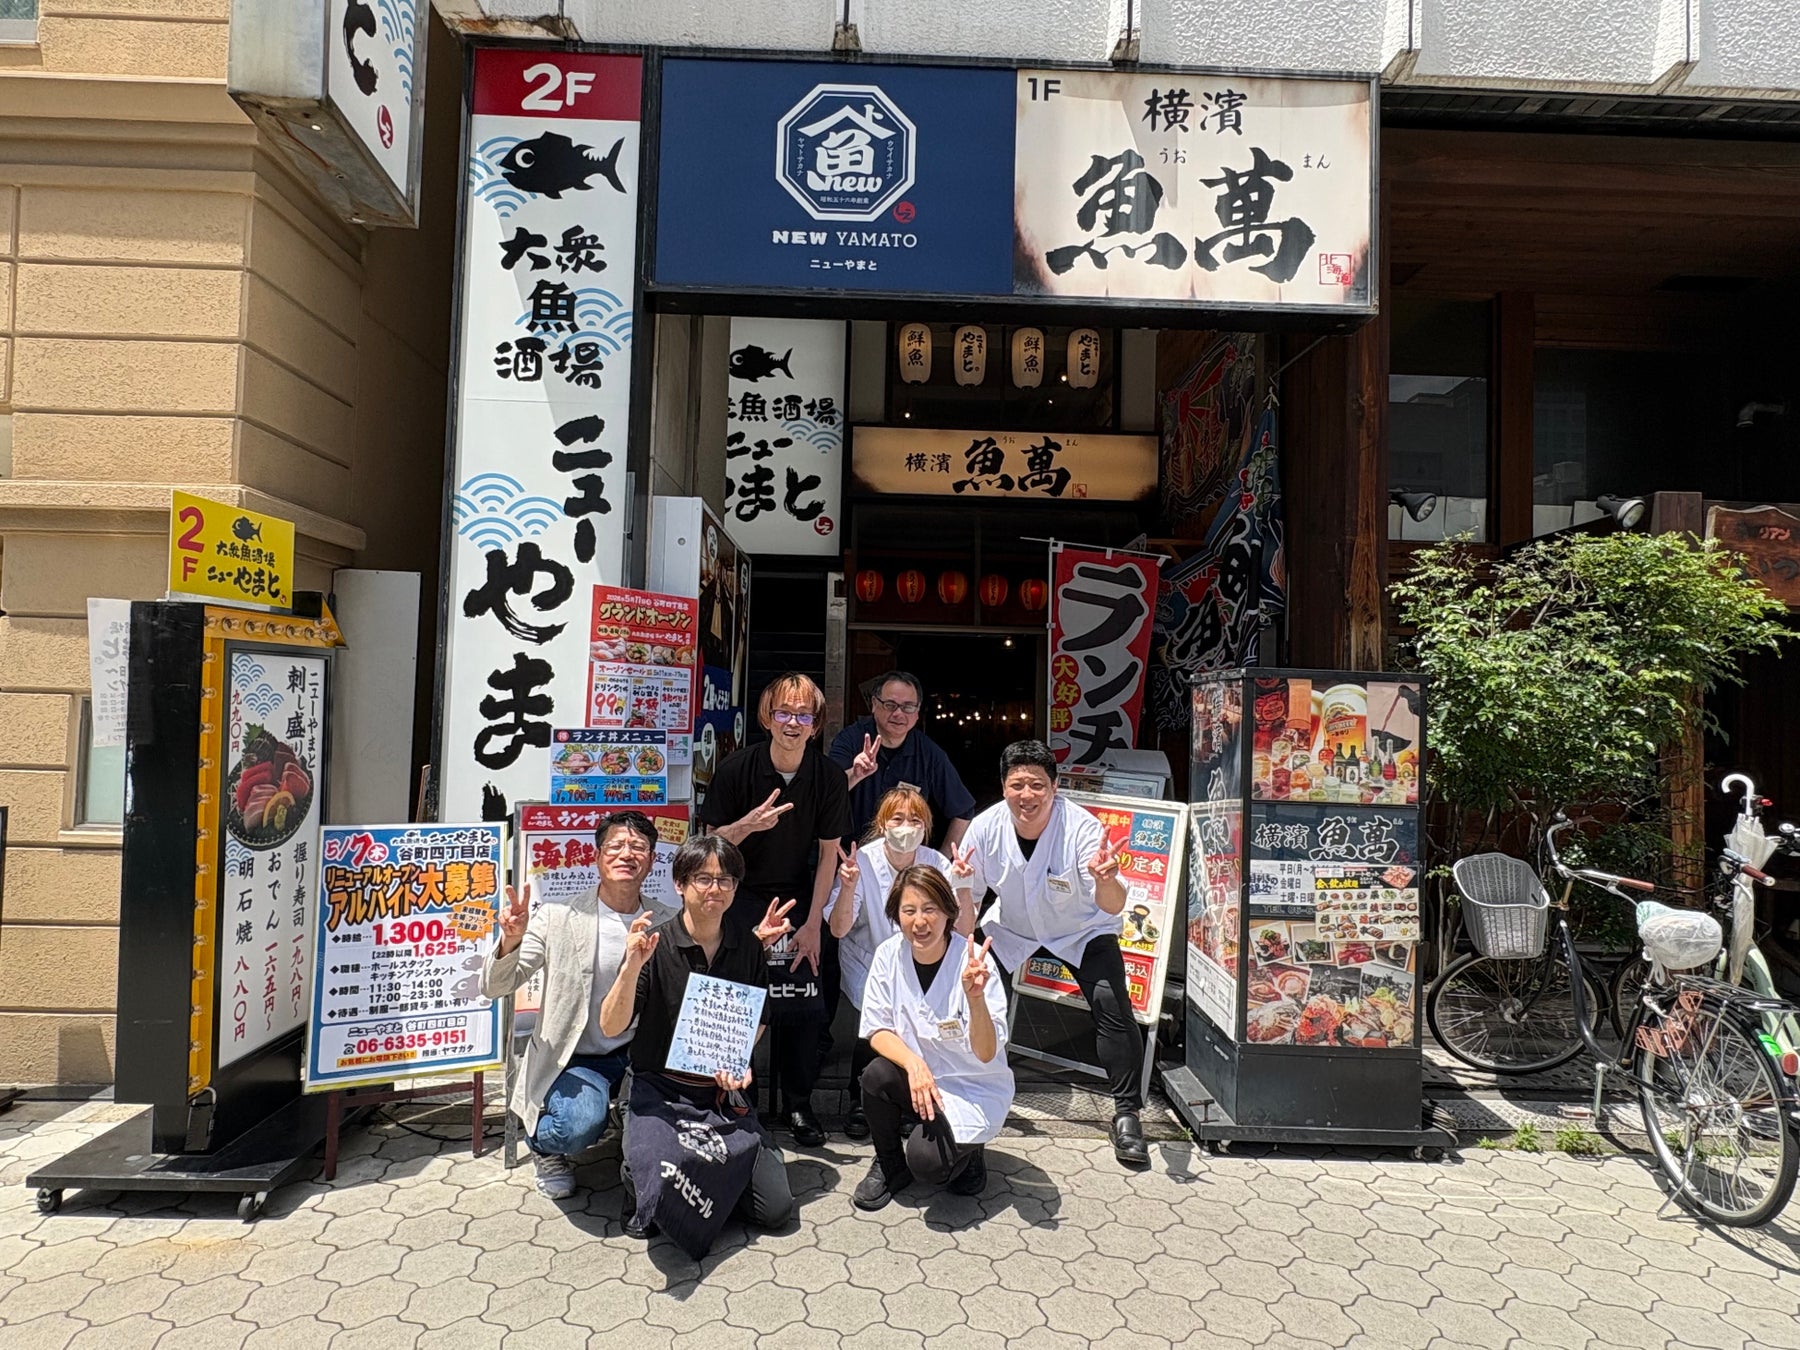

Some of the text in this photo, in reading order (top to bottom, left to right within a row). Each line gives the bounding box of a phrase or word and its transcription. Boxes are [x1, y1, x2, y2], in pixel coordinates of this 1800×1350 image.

[521, 63, 596, 111] 2F
[1028, 78, 1061, 101] 1F
[1142, 88, 1248, 135] 横濱
[1160, 148, 1187, 164] うお
[1302, 154, 1331, 169] まん
[1045, 147, 1317, 284] 魚萬
[499, 225, 607, 274] 大衆
[772, 230, 918, 248] NEW YAMATO
[810, 259, 878, 271] ニューやまと
[526, 279, 580, 333] 魚
[494, 336, 604, 389] 酒場
[907, 330, 926, 367] 鮮魚
[960, 332, 976, 373] やまと
[1023, 336, 1041, 373] 鮮魚
[904, 452, 951, 474] 横濱
[952, 436, 1071, 497] 魚萬
[552, 415, 613, 563] ニュー
[207, 566, 280, 599] ニューやまと
[599, 602, 692, 629] グランドオープン
[463, 543, 575, 820] やま
[1060, 566, 1146, 765] ランチ
[285, 665, 307, 757] 刺し盛り
[1051, 658, 1076, 729] 大好評
[307, 672, 319, 769] ニューやまと
[572, 731, 665, 742] ランチ丼メニュー
[325, 832, 372, 866] 5/7
[399, 845, 490, 861] 谷町四丁目店
[429, 830, 491, 845] ニューやまと
[1255, 823, 1310, 850] 横濱
[1309, 815, 1400, 864] 魚萬
[266, 852, 282, 930] おでん
[293, 842, 308, 928] 握り寿司
[325, 864, 420, 890] リニューアルオープン
[235, 857, 255, 945] 明石焼
[372, 920, 457, 946] 1,300円
[370, 967, 457, 981] キッチンアシスタント
[371, 959, 433, 971] ホールスタッフ
[348, 1023, 403, 1037] ニューやまと
[356, 1029, 466, 1054] 06-6335-9151
[660, 1160, 714, 1219] アサヒビール
